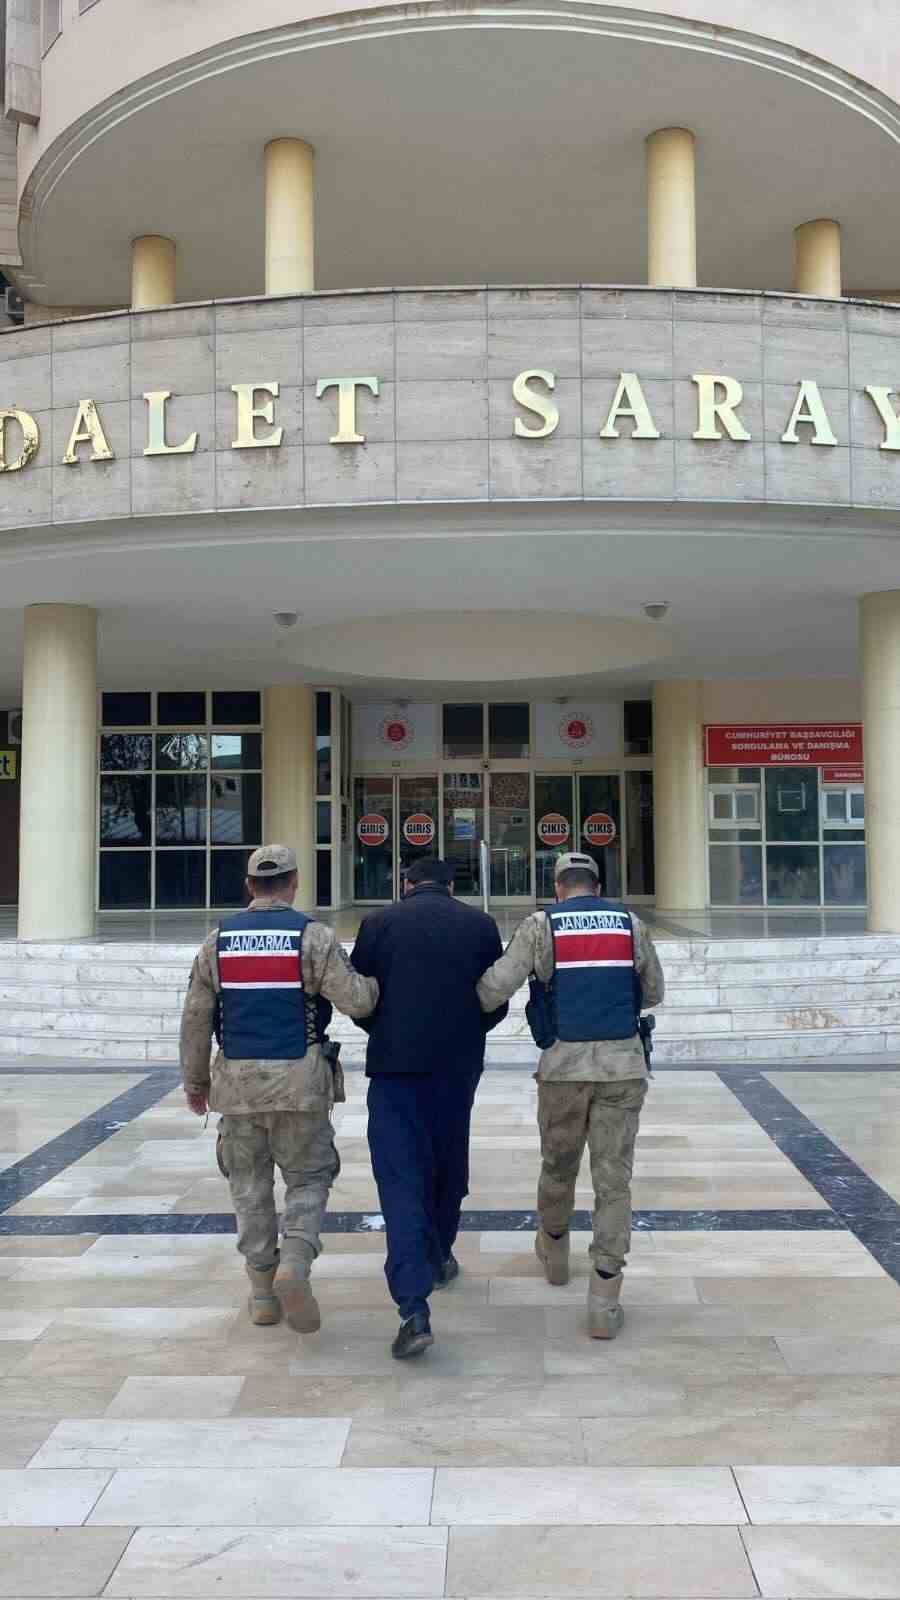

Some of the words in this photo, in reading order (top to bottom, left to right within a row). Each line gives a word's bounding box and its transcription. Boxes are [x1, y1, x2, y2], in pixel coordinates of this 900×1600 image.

[0, 376, 380, 473] DALET
[512, 368, 900, 450] SARAY
[558, 914, 624, 931] JANDARMA
[226, 935, 292, 951] JANDARMA
